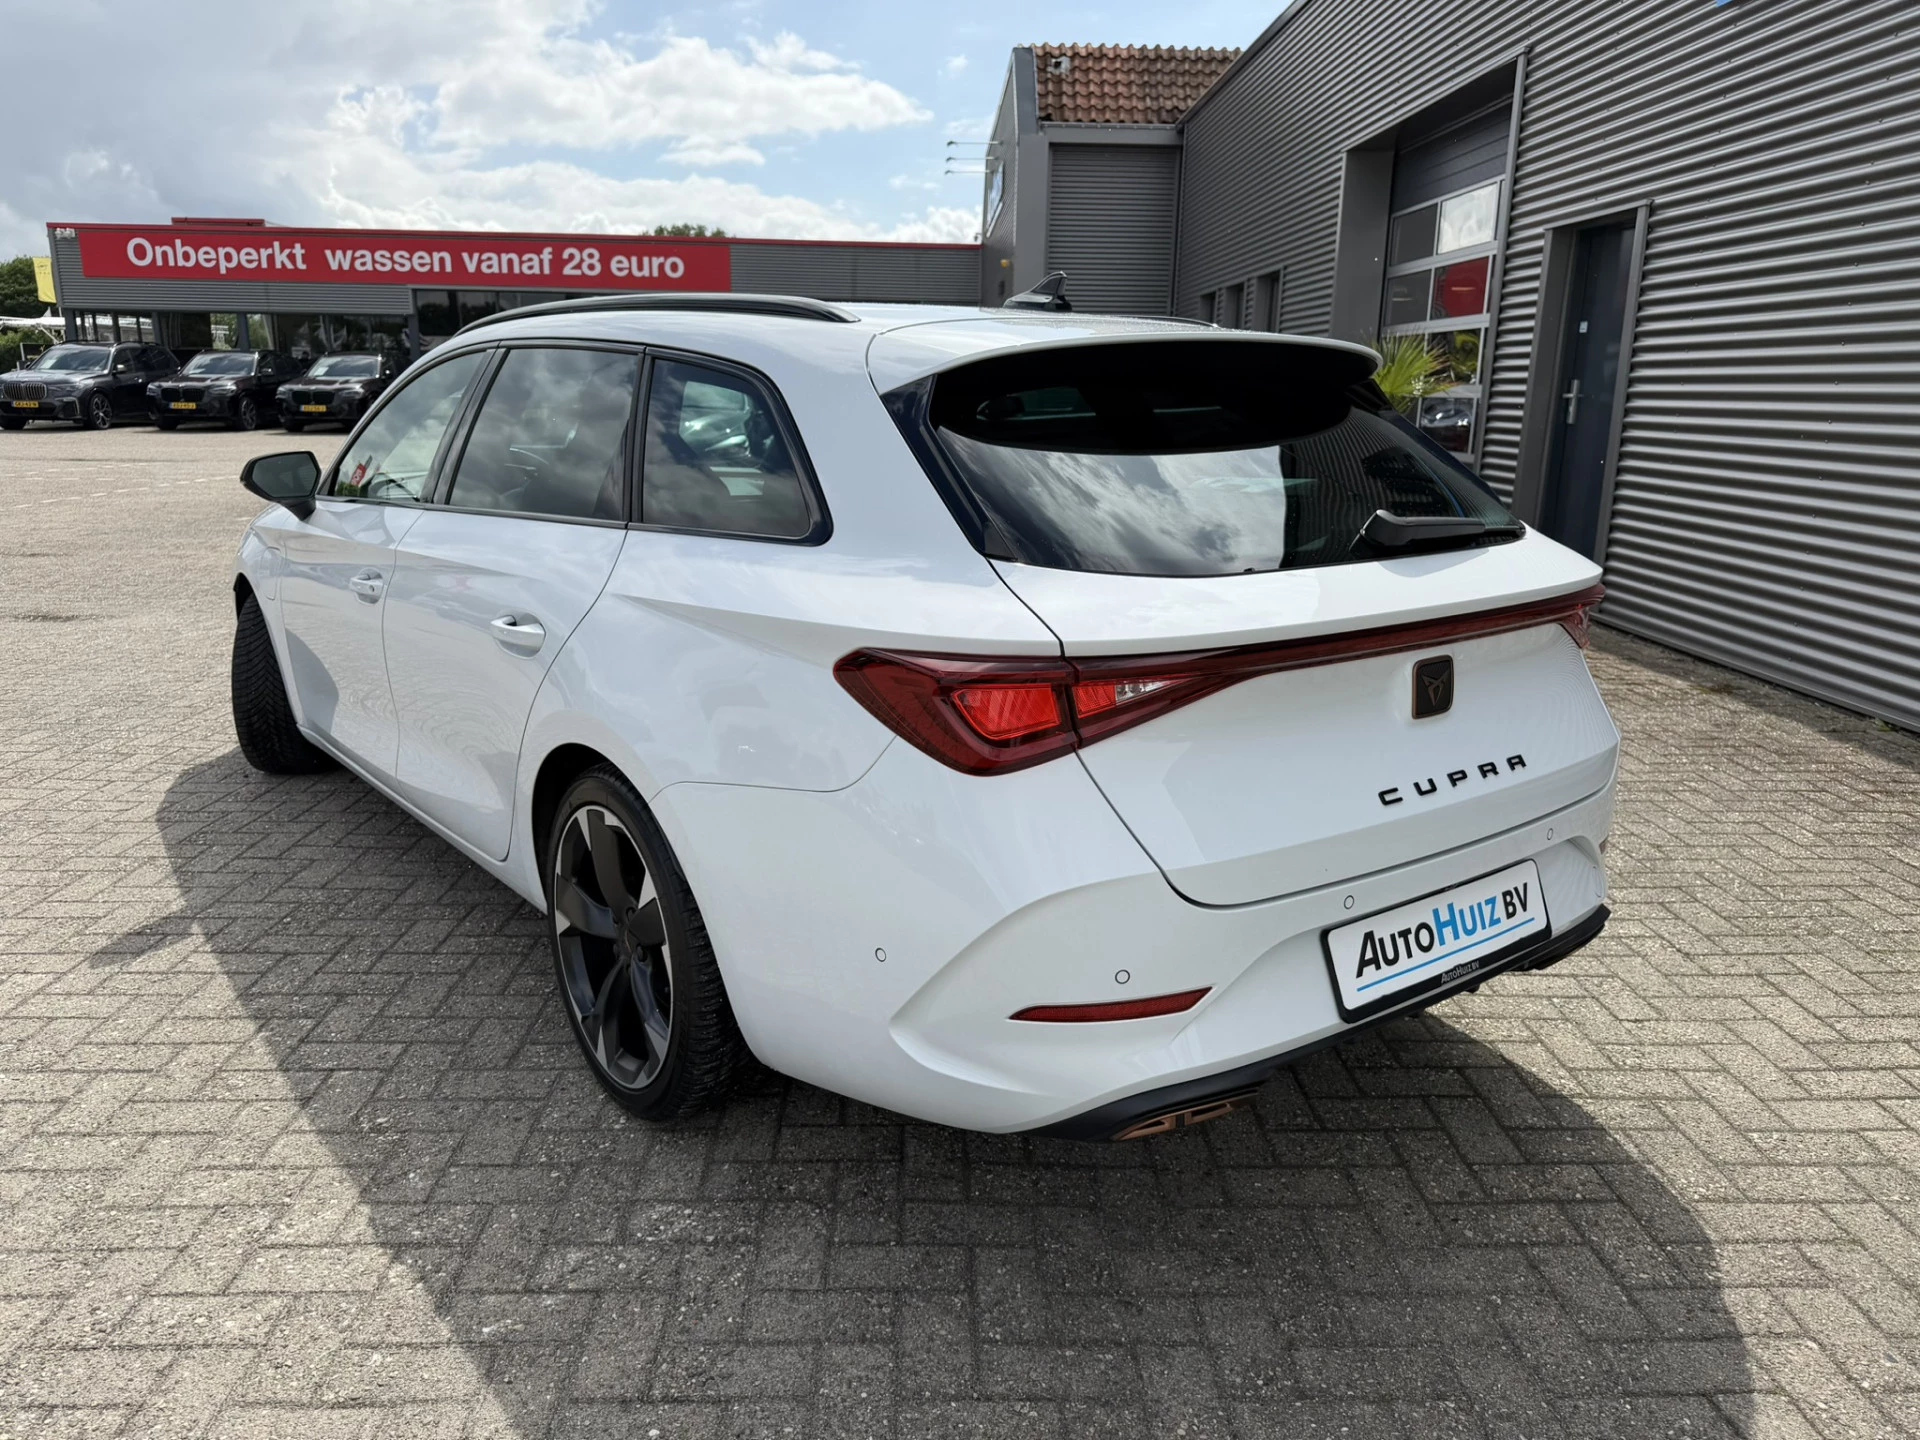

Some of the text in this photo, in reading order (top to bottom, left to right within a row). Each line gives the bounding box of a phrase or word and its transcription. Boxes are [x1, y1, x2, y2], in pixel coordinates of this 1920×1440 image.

[126, 237, 685, 279] Onbeperkt wassen vanaf 28 euro
[1378, 753, 1527, 806] CUPRA
[1501, 882, 1528, 920] BV
